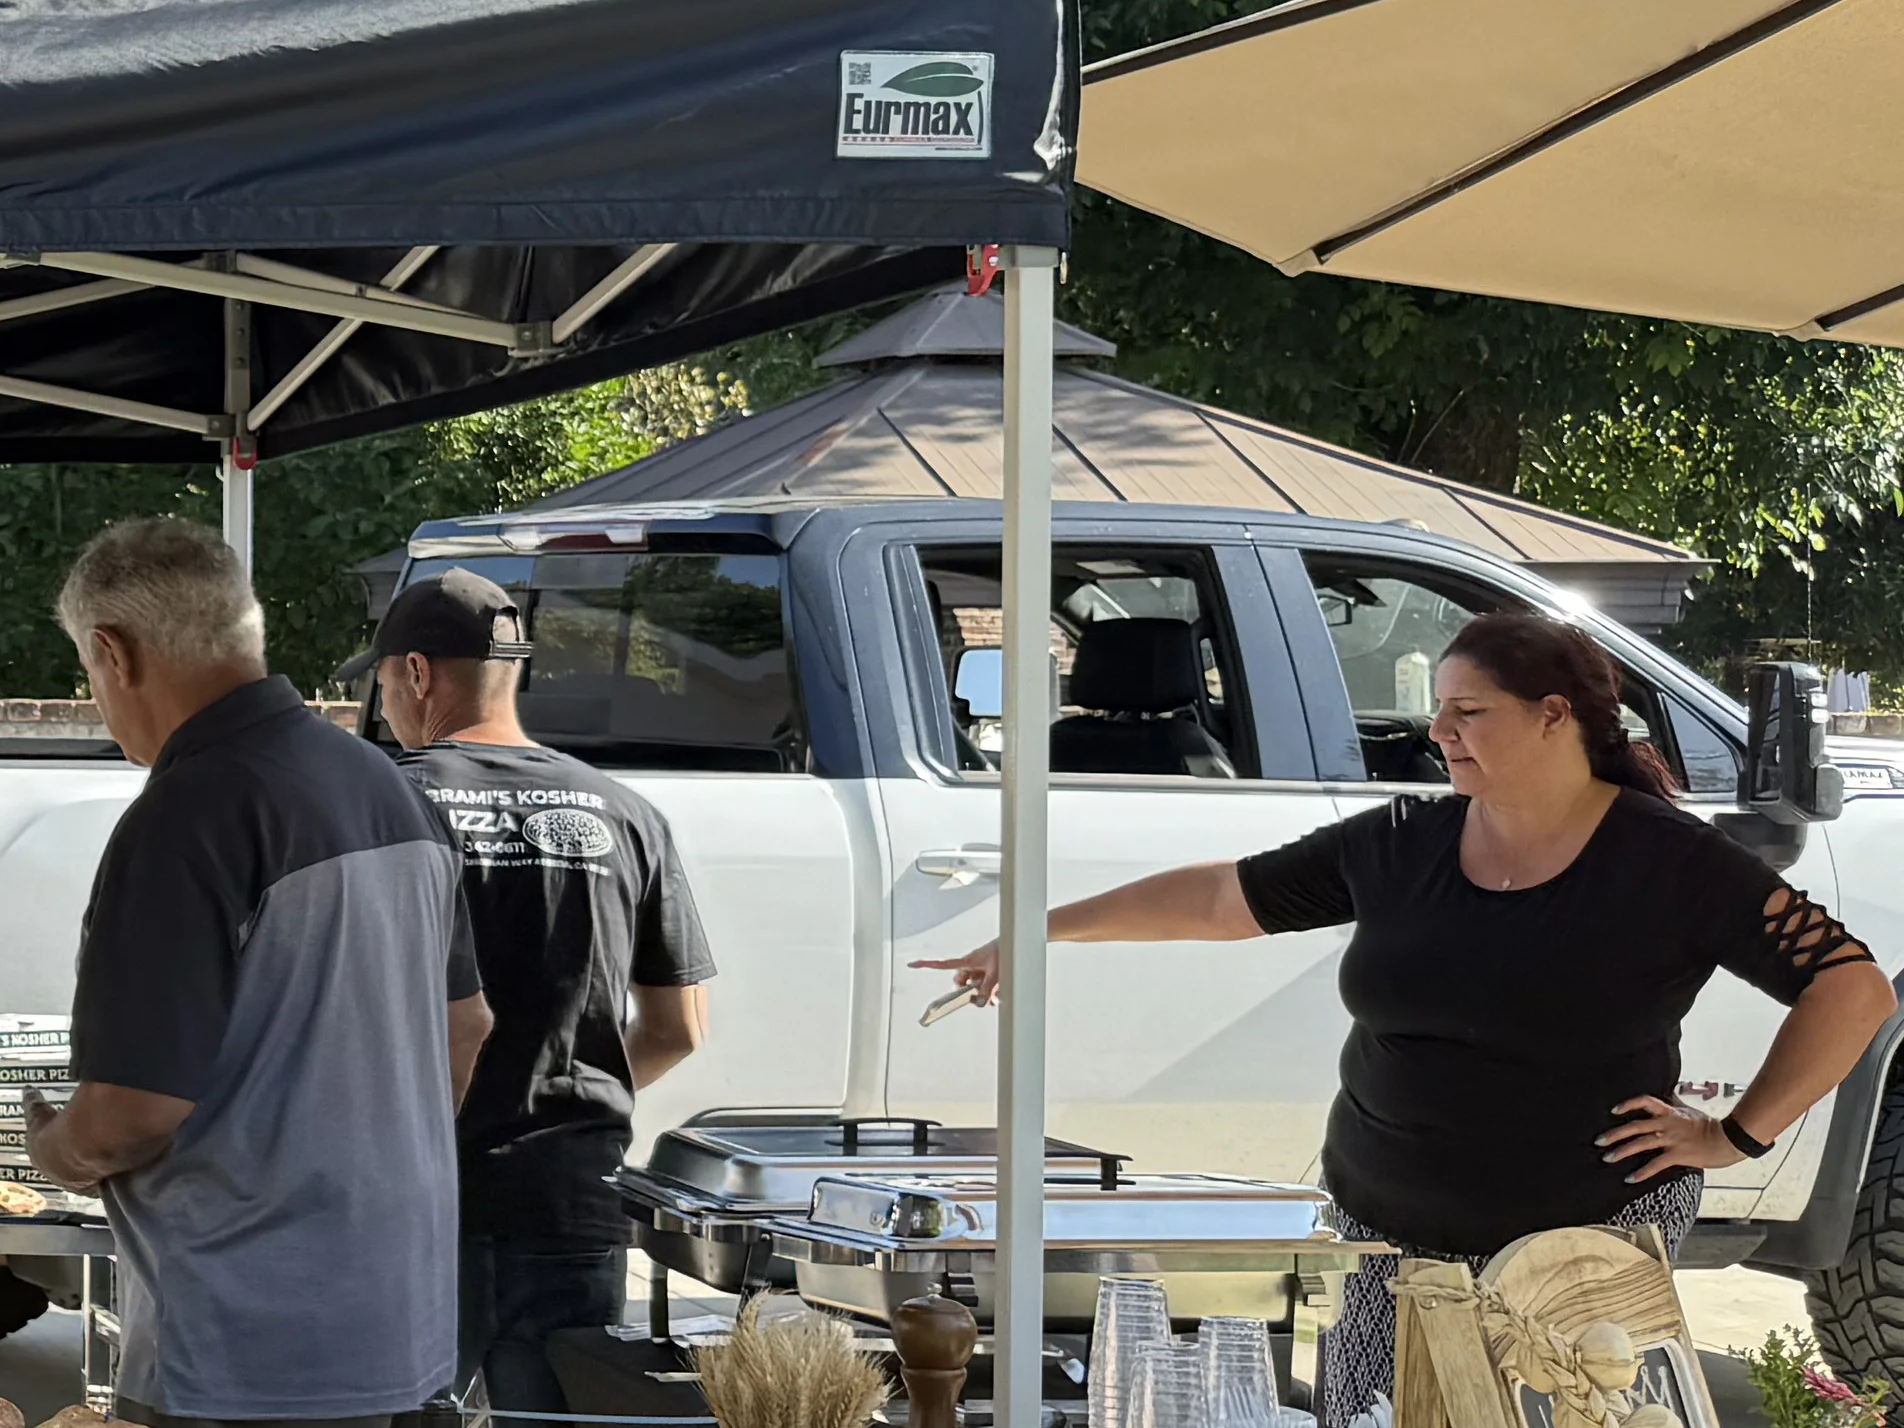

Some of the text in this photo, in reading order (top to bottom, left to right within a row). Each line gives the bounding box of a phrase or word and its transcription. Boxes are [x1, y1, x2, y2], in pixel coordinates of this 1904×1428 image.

[843, 92, 974, 136] Eurmax
[516, 789, 607, 810] KOSHER
[448, 808, 520, 833] IZZA
[11, 1032, 60, 1047] KOSHER
[48, 1068, 70, 1081] PIZ
